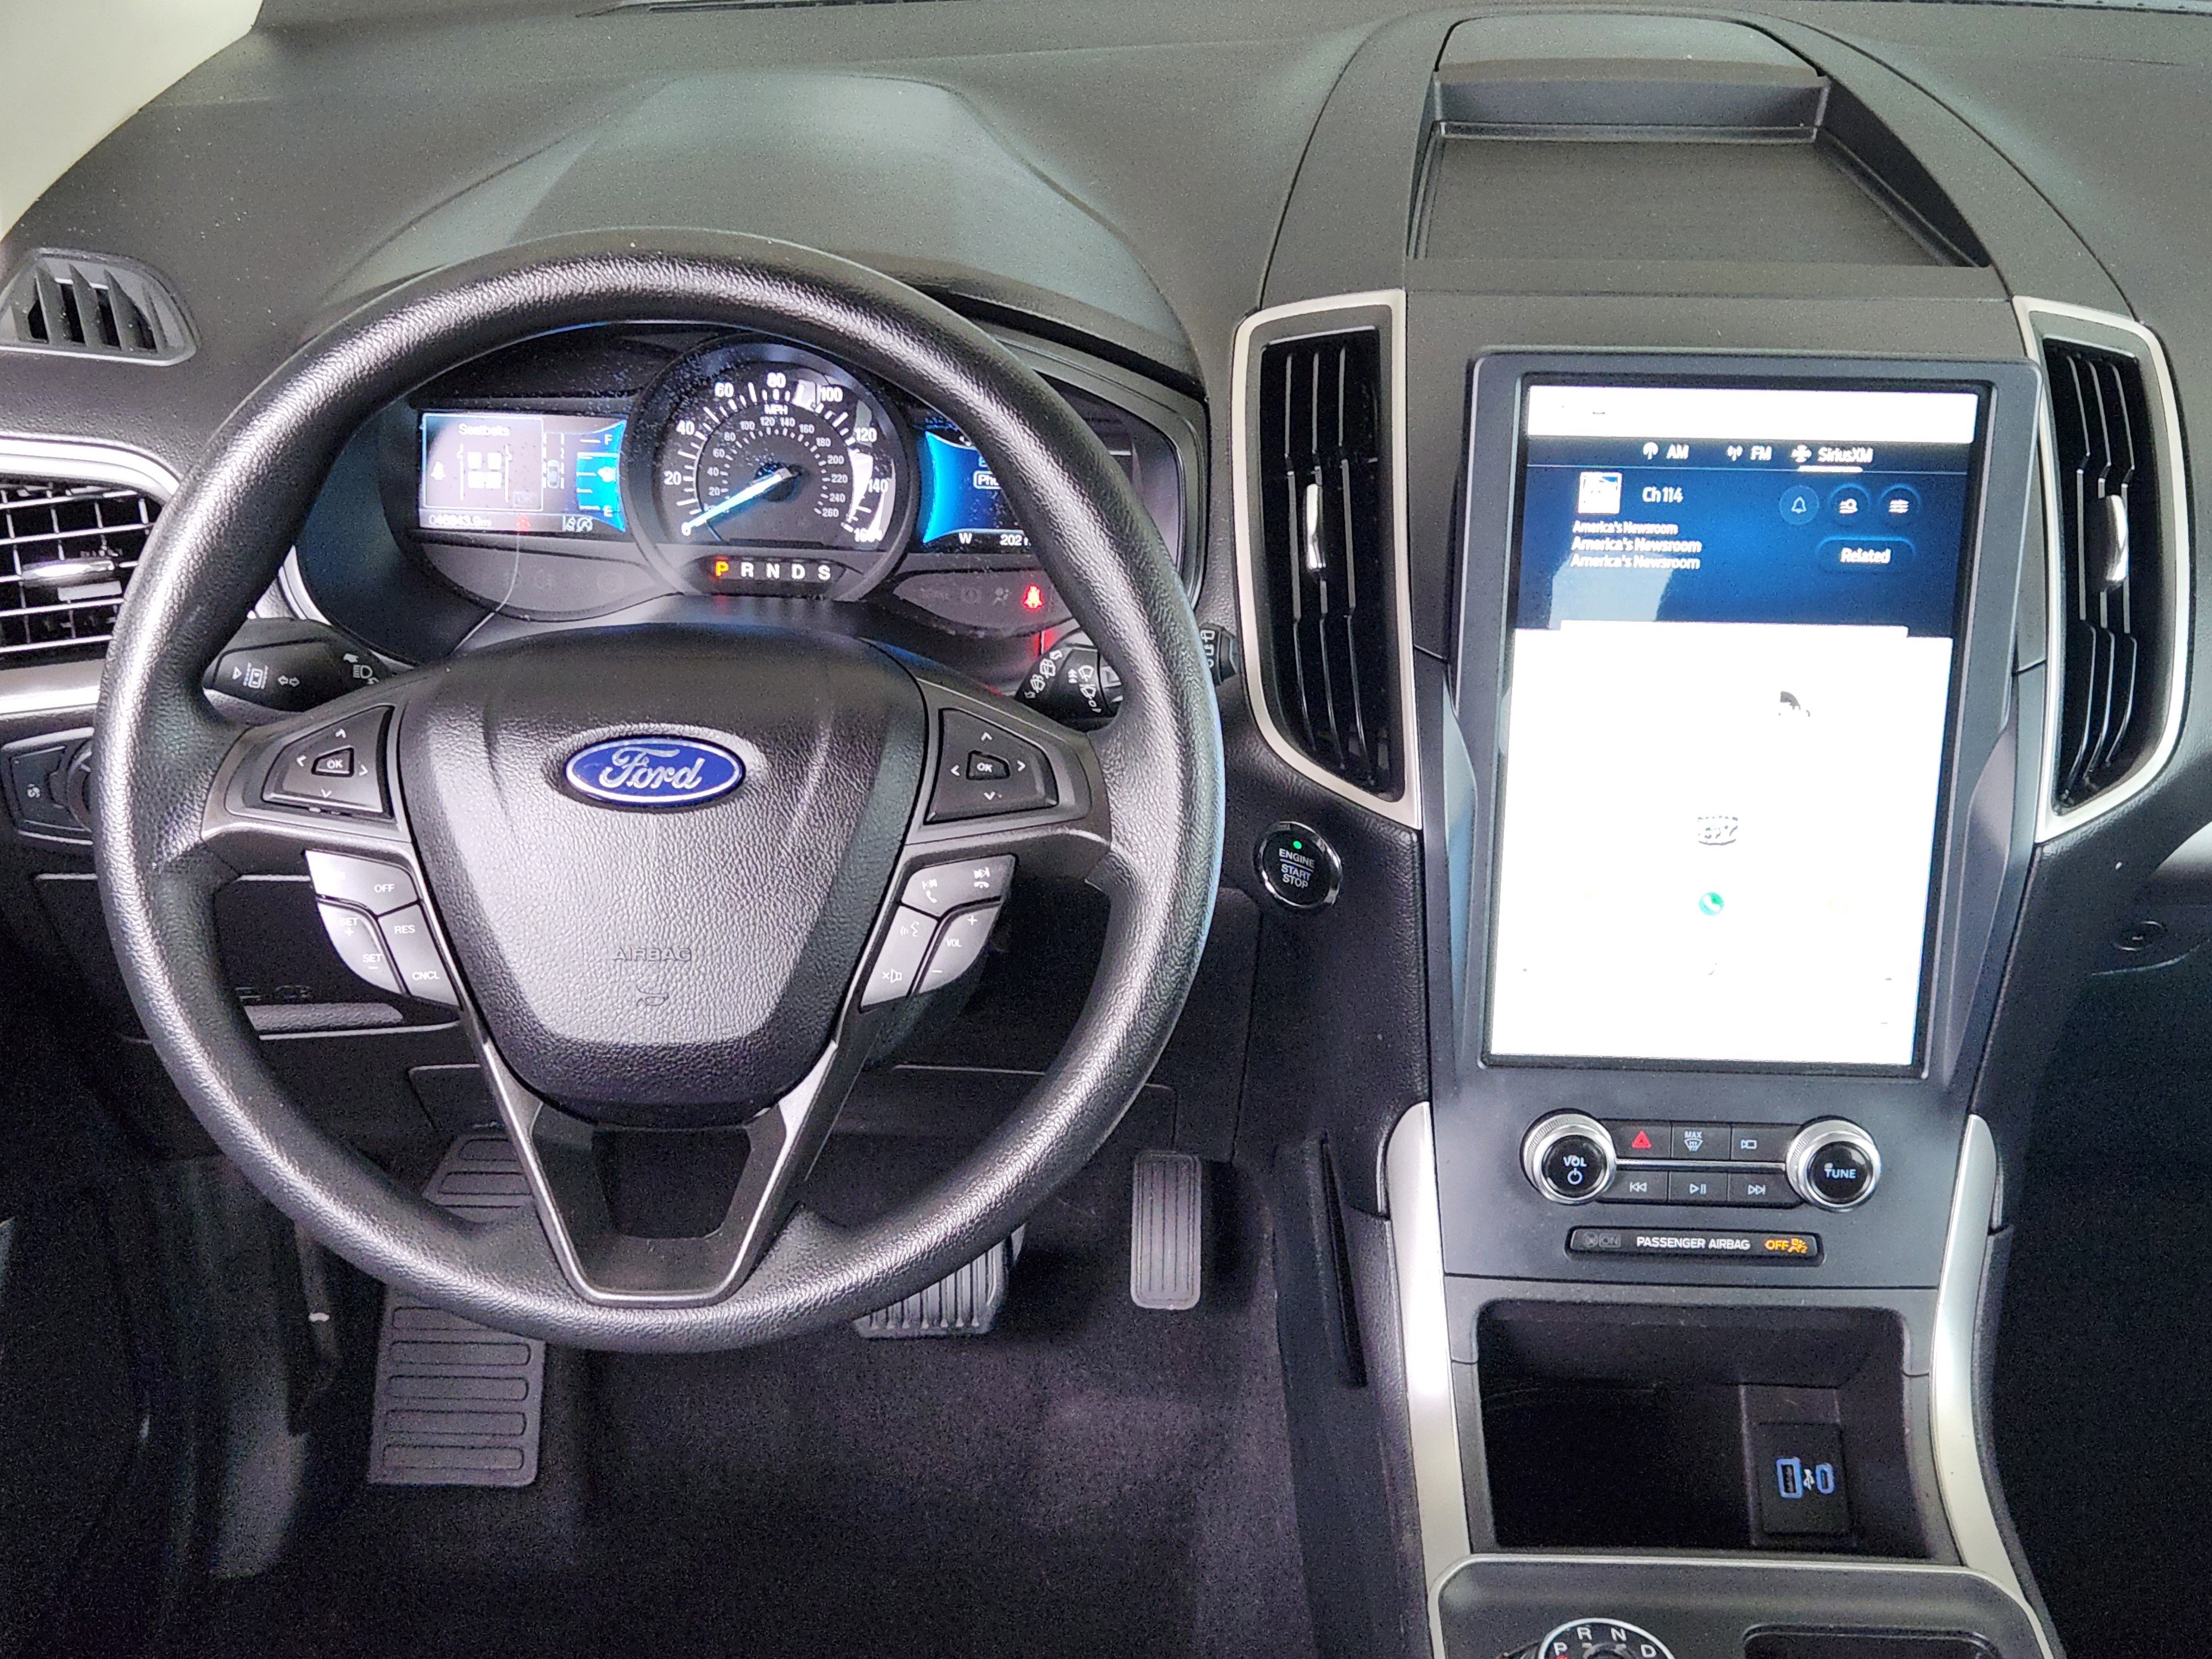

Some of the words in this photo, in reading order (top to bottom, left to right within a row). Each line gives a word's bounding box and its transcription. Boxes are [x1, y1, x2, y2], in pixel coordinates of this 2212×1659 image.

[767, 373, 786, 388] 80
[715, 383, 734, 398] 60
[820, 387, 843, 402] 100
[764, 404, 788, 415] MPH
[739, 421, 755, 430] 100
[760, 416, 775, 426] 120
[780, 417, 796, 427] 140
[458, 423, 510, 437] Seatbelts
[676, 421, 695, 435] 40
[799, 424, 815, 434] 160
[604, 435, 613, 445] F
[724, 432, 736, 442] 80
[855, 428, 877, 442] 120
[816, 437, 831, 447] 180
[713, 448, 726, 458] 60
[1667, 444, 1689, 460] AM
[1750, 445, 1772, 461] FM
[1817, 447, 1874, 463] SiriusXM
[827, 455, 844, 465] 200
[664, 471, 681, 485] 20
[707, 467, 719, 477] 40
[831, 474, 848, 484] 220
[709, 487, 720, 497] 20
[868, 479, 888, 493] 140
[830, 493, 846, 503] 240
[603, 505, 613, 517] E
[822, 508, 839, 518] 260
[1572, 520, 1623, 534] America's
[1623, 521, 1679, 535] Newsroom
[959, 533, 972, 544] W
[1000, 534, 1022, 546] 202
[1571, 536, 1634, 551] America's
[1634, 537, 1702, 552] Newsroom
[1840, 547, 1891, 564] Related
[1570, 554, 1632, 568] America's
[1633, 555, 1701, 570] Newsroom
[716, 561, 729, 576] P
[741, 563, 754, 577] R
[766, 564, 780, 578] N
[792, 564, 805, 578] D
[818, 565, 831, 580] S
[327, 759, 343, 769] OK
[599, 747, 705, 789] Ford
[977, 762, 993, 773] OK
[1279, 848, 1315, 868] ENGINE
[1281, 863, 1312, 881] START
[1282, 873, 1308, 889] STOP
[374, 884, 395, 893] OFF
[338, 917, 359, 926] SET
[394, 925, 415, 934] RES
[946, 937, 962, 947] VOL
[363, 953, 382, 963] SET
[612, 946, 691, 962] AIRBAG
[412, 971, 440, 981] CNCL
[1684, 1130, 1702, 1139] MAX
[1563, 1156, 1587, 1168] VOL
[1824, 1167, 1856, 1180] TUNE
[1636, 1236, 1705, 1249] PASSENGER
[1709, 1238, 1751, 1250] AIRBAG
[1765, 1240, 1790, 1250] OFF
[1577, 1627, 1593, 1640] R
[1610, 1628, 1627, 1641] N
[1553, 1641, 1568, 1656] P
[1640, 1644, 1657, 1658] D
